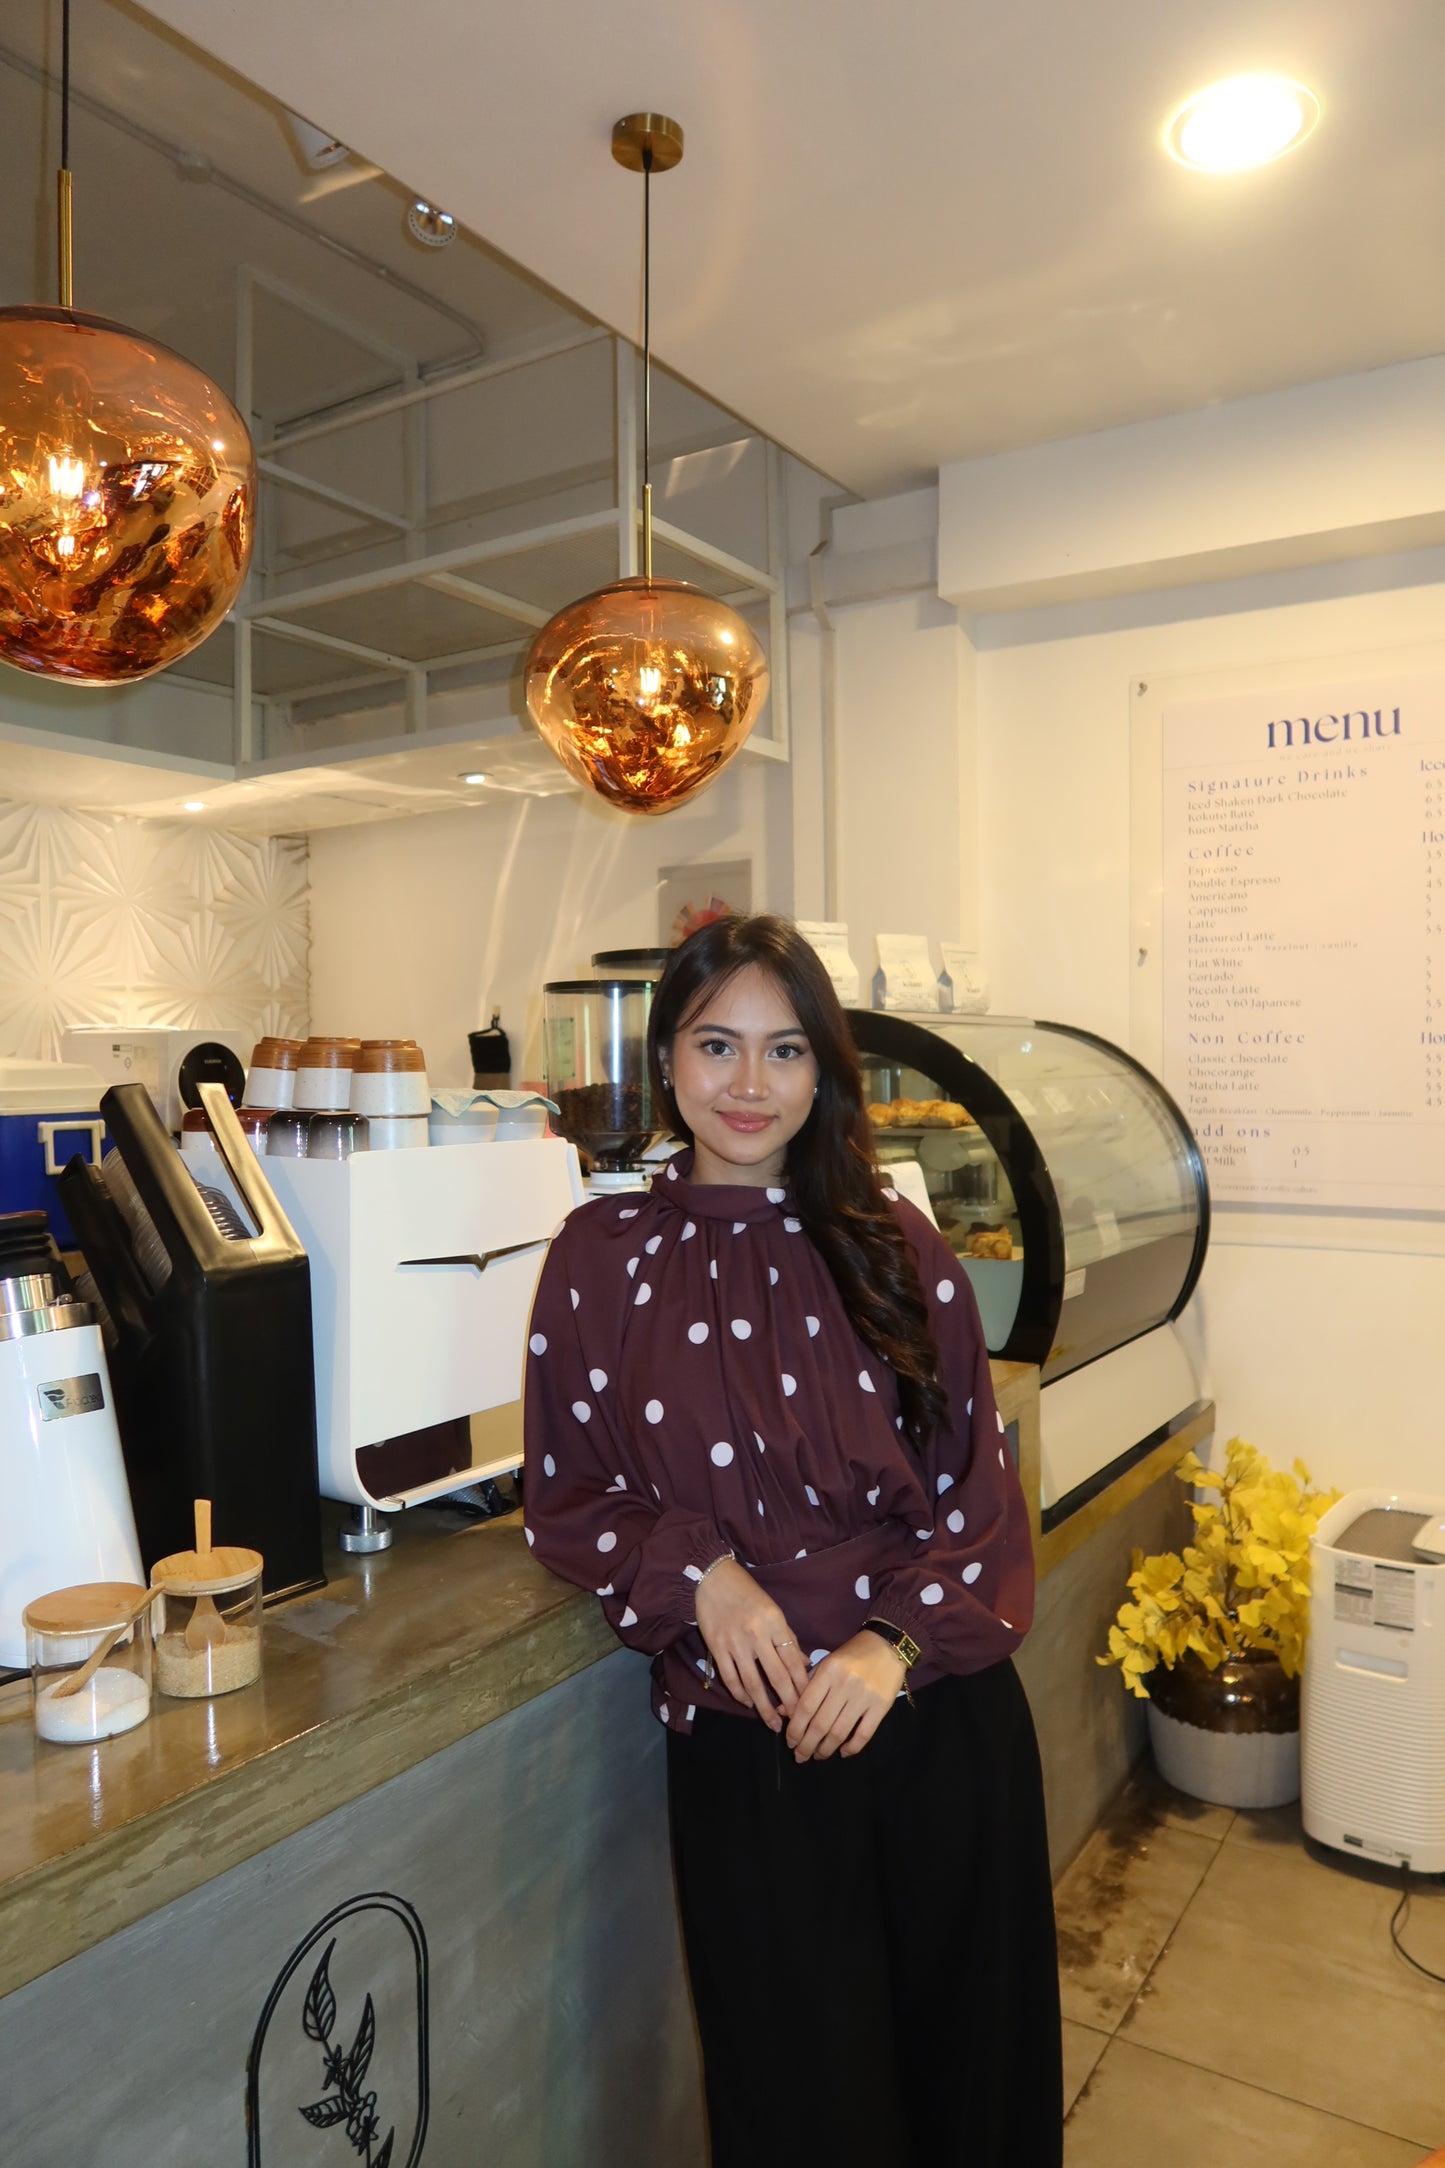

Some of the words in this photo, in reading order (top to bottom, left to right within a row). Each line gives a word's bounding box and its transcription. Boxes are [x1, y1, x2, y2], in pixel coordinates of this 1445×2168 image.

[1267, 707, 1401, 748] menu
[1188, 774, 1287, 794] Signature
[1298, 766, 1369, 783] Drinks
[1188, 798, 1211, 810] Iced
[1214, 795, 1254, 808] Shaken
[1257, 792, 1284, 804] Dark
[1287, 788, 1348, 802] Chocolate
[1218, 820, 1259, 833] Matcha
[1188, 843, 1255, 859] Coffee
[1188, 864, 1238, 876] Espresso
[1188, 877, 1227, 889] Double
[1230, 875, 1281, 888] Espresso
[1188, 891, 1248, 902] Americano
[1188, 920, 1216, 930] Latte
[1188, 931, 1244, 944] Flavoured
[1246, 931, 1275, 942] Latte
[1188, 958, 1209, 970] Flat
[1211, 957, 1244, 968] White
[1188, 971, 1234, 982] Cortado
[1188, 985, 1229, 996] Piccolo
[1231, 984, 1260, 995] Latte
[1188, 999, 1210, 1009] V60
[1225, 998, 1248, 1009] V60
[1249, 997, 1302, 1011] Japanese
[1188, 1011, 1225, 1023] Mocha
[1188, 1032, 1225, 1045] Non
[1237, 1030, 1306, 1045] Coffee
[1188, 1054, 1227, 1065] Classic
[1230, 1054, 1288, 1065] Chocolate
[1188, 1067, 1256, 1079] Chocorange
[1188, 1080, 1228, 1091] Matcha
[1231, 1081, 1260, 1091] Latte
[1188, 1095, 1208, 1104] Tea
[1236, 1127, 1271, 1137] ons
[1222, 1143, 1247, 1154] Shot
[1292, 1146, 1310, 1157] 0.5
[1213, 1156, 1237, 1166] Milk
